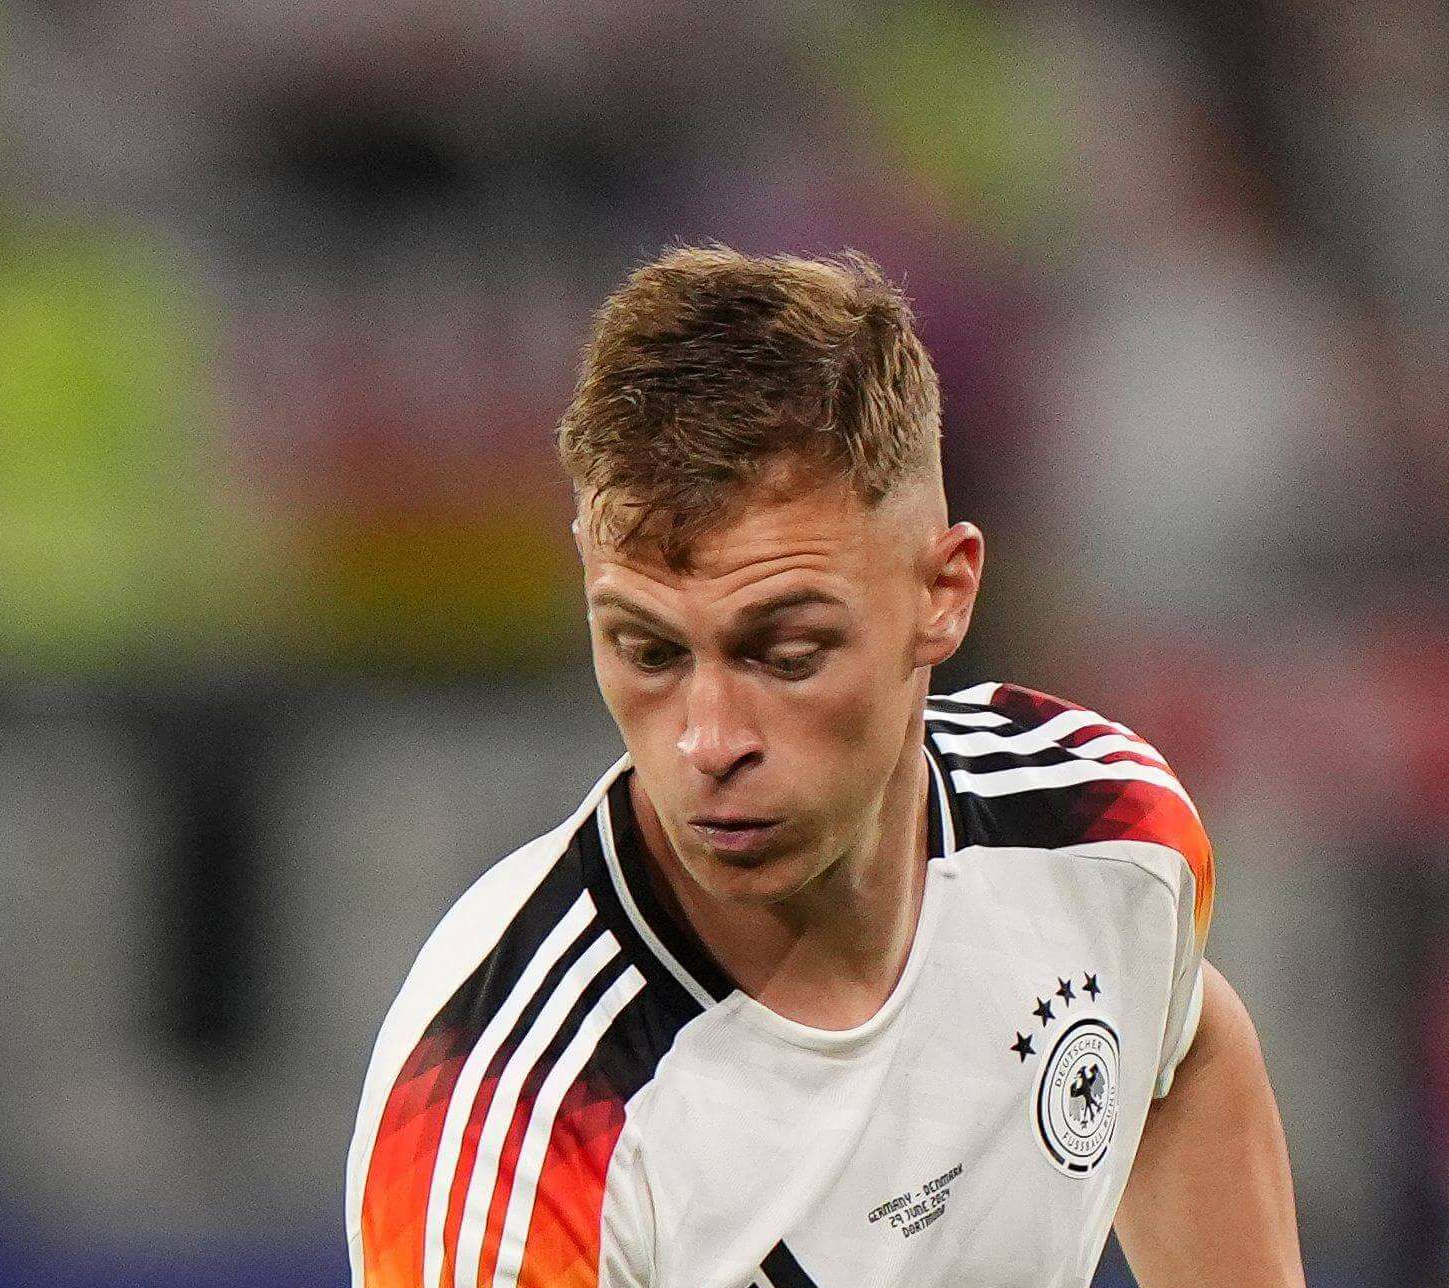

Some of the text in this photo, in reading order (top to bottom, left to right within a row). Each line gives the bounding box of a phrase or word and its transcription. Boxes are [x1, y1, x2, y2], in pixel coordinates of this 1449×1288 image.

[1055, 1039, 1103, 1088] DEUTSCHER
[868, 1192, 912, 1223] GERMANY
[922, 1163, 963, 1196] DENMARK
[889, 1213, 904, 1228] 29
[904, 1200, 929, 1221] JUNE
